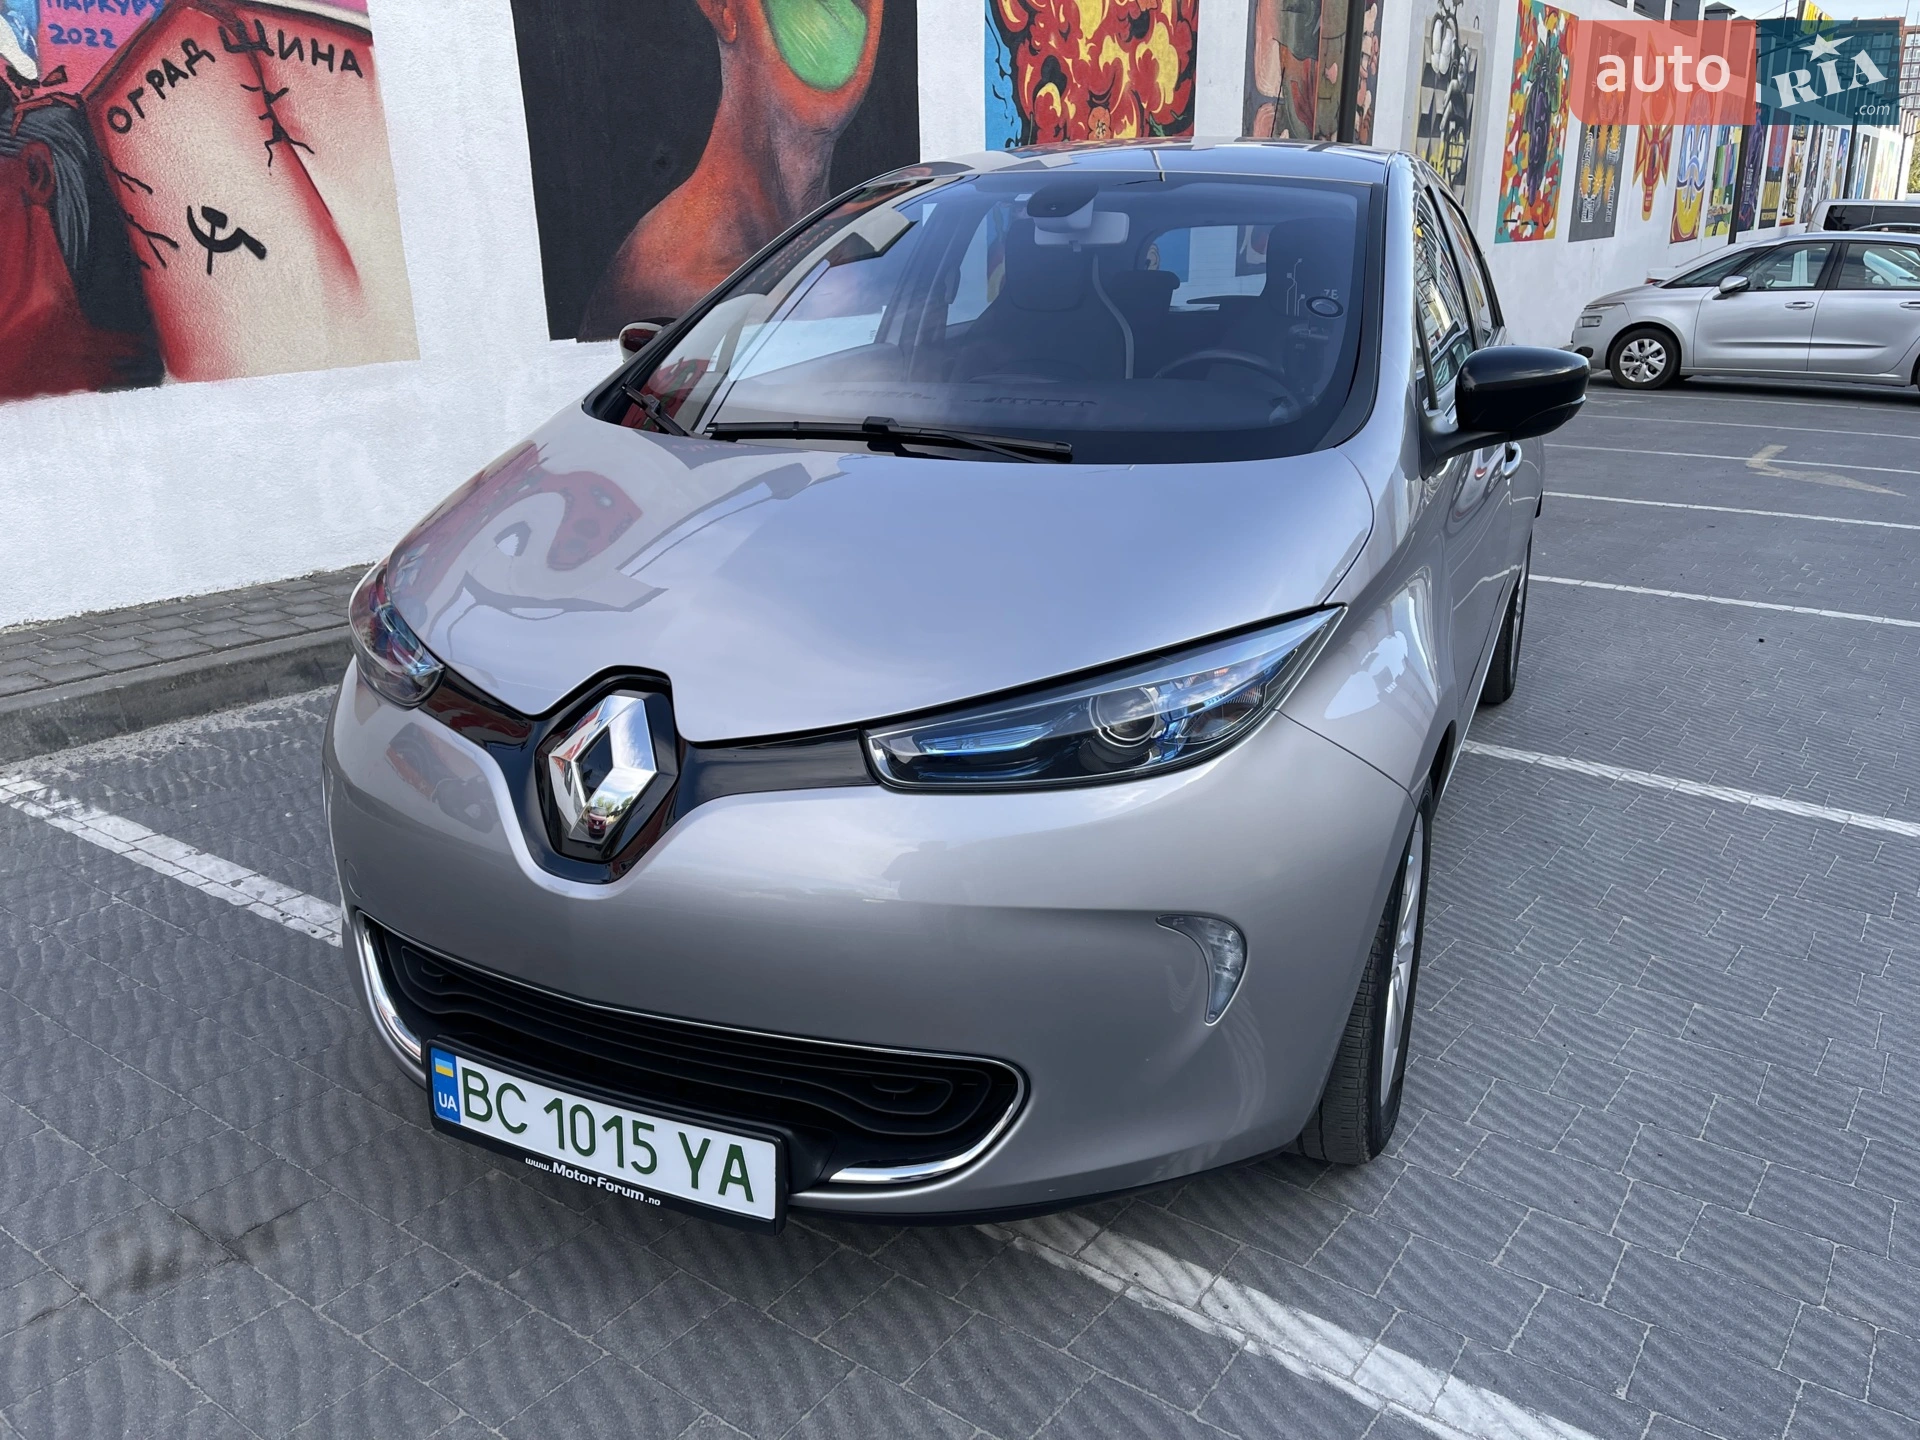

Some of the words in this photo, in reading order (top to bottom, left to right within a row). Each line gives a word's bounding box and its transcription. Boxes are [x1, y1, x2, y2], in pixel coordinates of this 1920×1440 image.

[48, 23, 117, 49] 2022
[438, 1091, 458, 1112] UA
[461, 1066, 528, 1134] BC
[543, 1097, 658, 1175] 1015
[678, 1131, 755, 1203] YA
[525, 1157, 661, 1206] www.MotorForum.no
